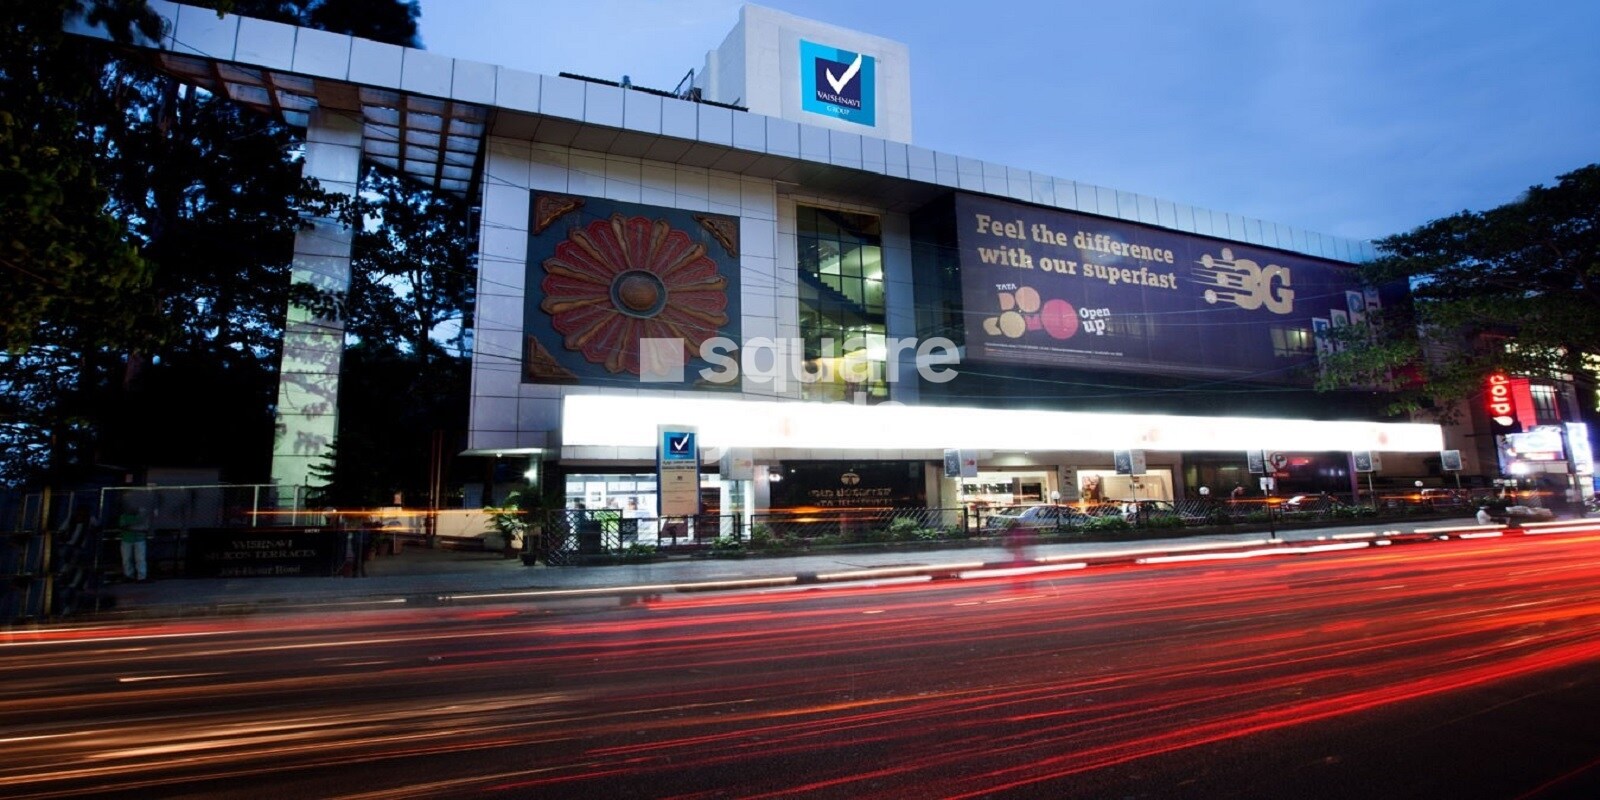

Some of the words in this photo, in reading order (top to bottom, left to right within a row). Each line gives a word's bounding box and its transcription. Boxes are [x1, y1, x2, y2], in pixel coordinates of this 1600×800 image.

[817, 90, 861, 107] VAISHNAVI
[826, 105, 850, 115] GROUP
[976, 213, 1027, 241] Feel
[1031, 223, 1068, 250] the
[1073, 231, 1175, 265] difference
[977, 245, 1034, 269] with
[1039, 258, 1077, 276] our
[1083, 264, 1178, 291] superfast
[995, 283, 1017, 291] TATA
[1230, 257, 1295, 315] 3G
[1079, 307, 1111, 320] Open
[1082, 318, 1107, 336] up
